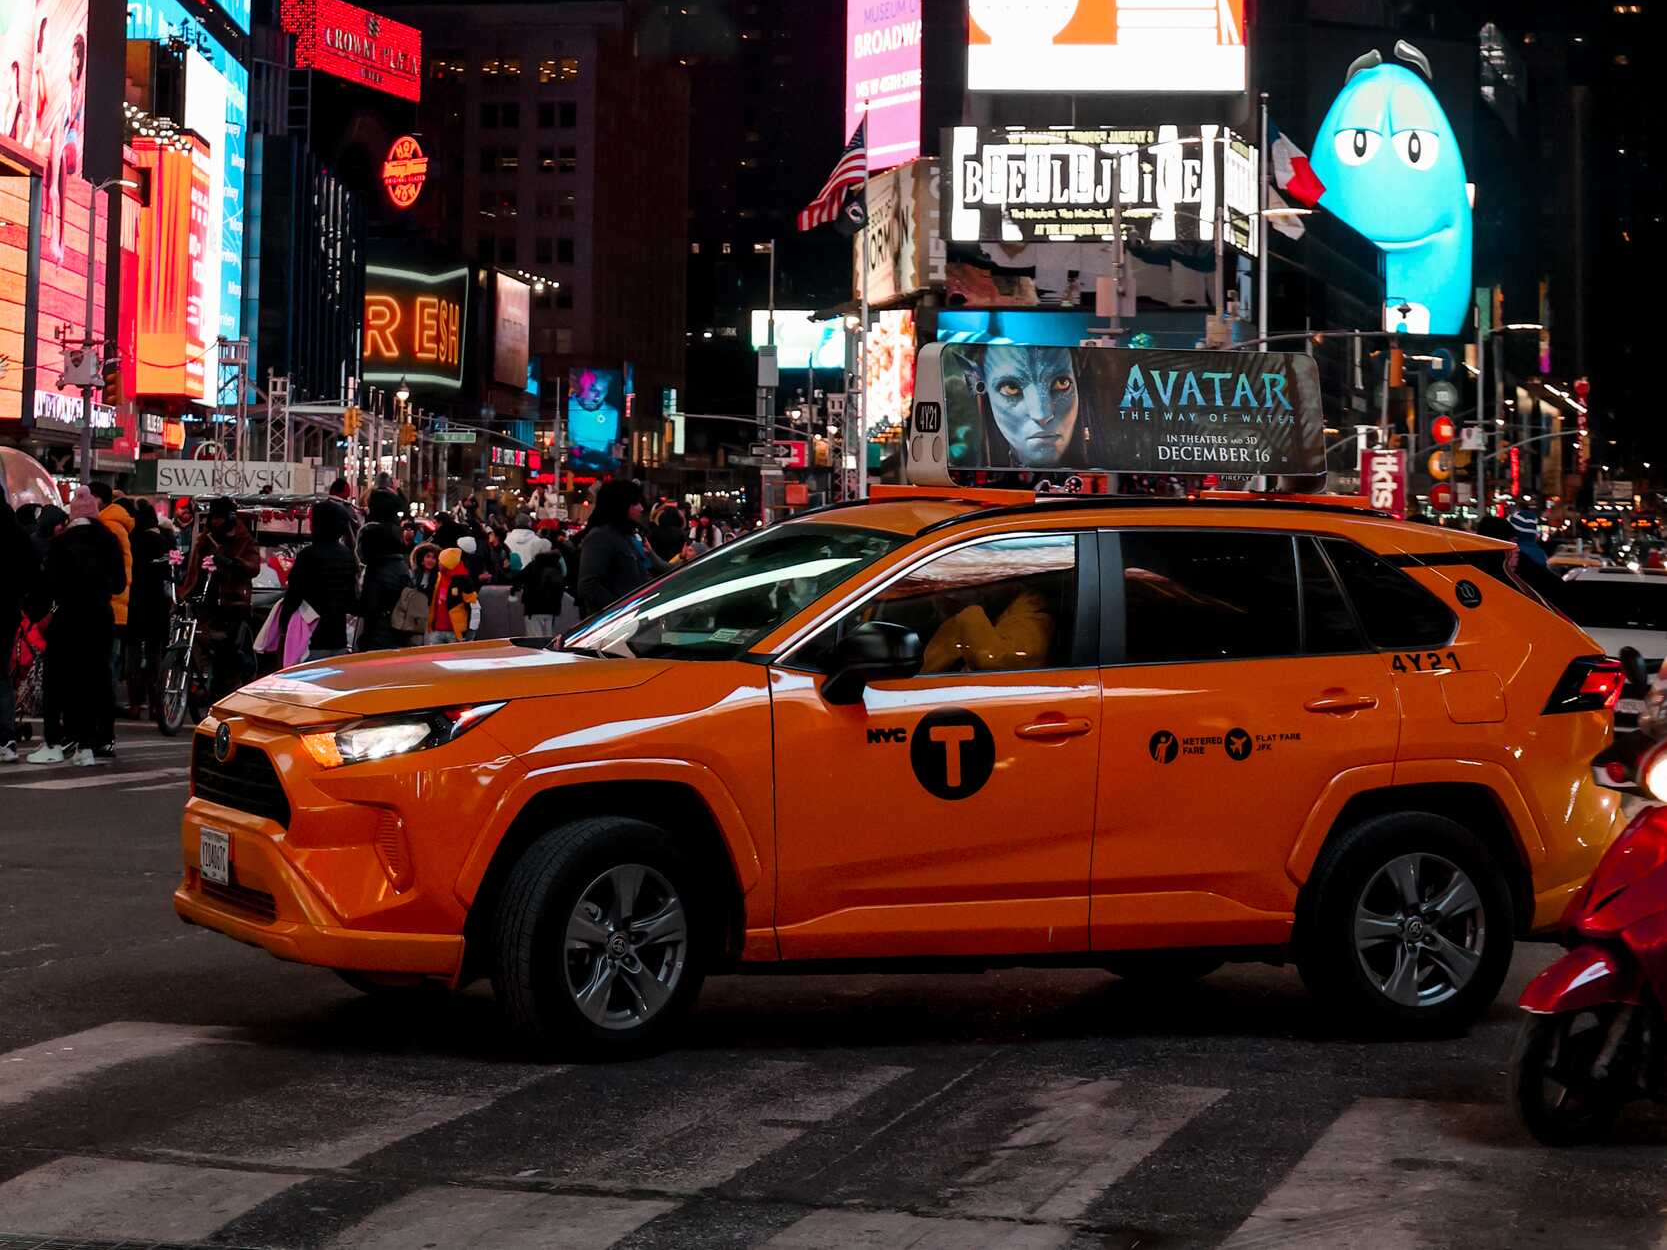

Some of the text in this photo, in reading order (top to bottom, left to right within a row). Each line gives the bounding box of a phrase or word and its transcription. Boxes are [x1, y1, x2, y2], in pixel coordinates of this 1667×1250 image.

[326, 27, 376, 62] CROWNE
[395, 141, 417, 158] HOT
[1120, 364, 1293, 411] AVATAR
[919, 405, 937, 430] 4Y21
[1120, 411, 1295, 425] THE WAY OF WATER
[1167, 435, 1178, 444] IN
[1179, 435, 1227, 445] THEATRES
[1245, 436, 1258, 446] 3D
[1158, 446, 1270, 463] DECEMBER 16
[159, 467, 291, 490] SWAROVSKI
[1392, 652, 1462, 674] 4Y21
[1182, 736, 1223, 746] METERED
[1255, 733, 1302, 743] FLAT FARE
[866, 725, 979, 787] NYC T
[1183, 746, 1206, 755] FARE
